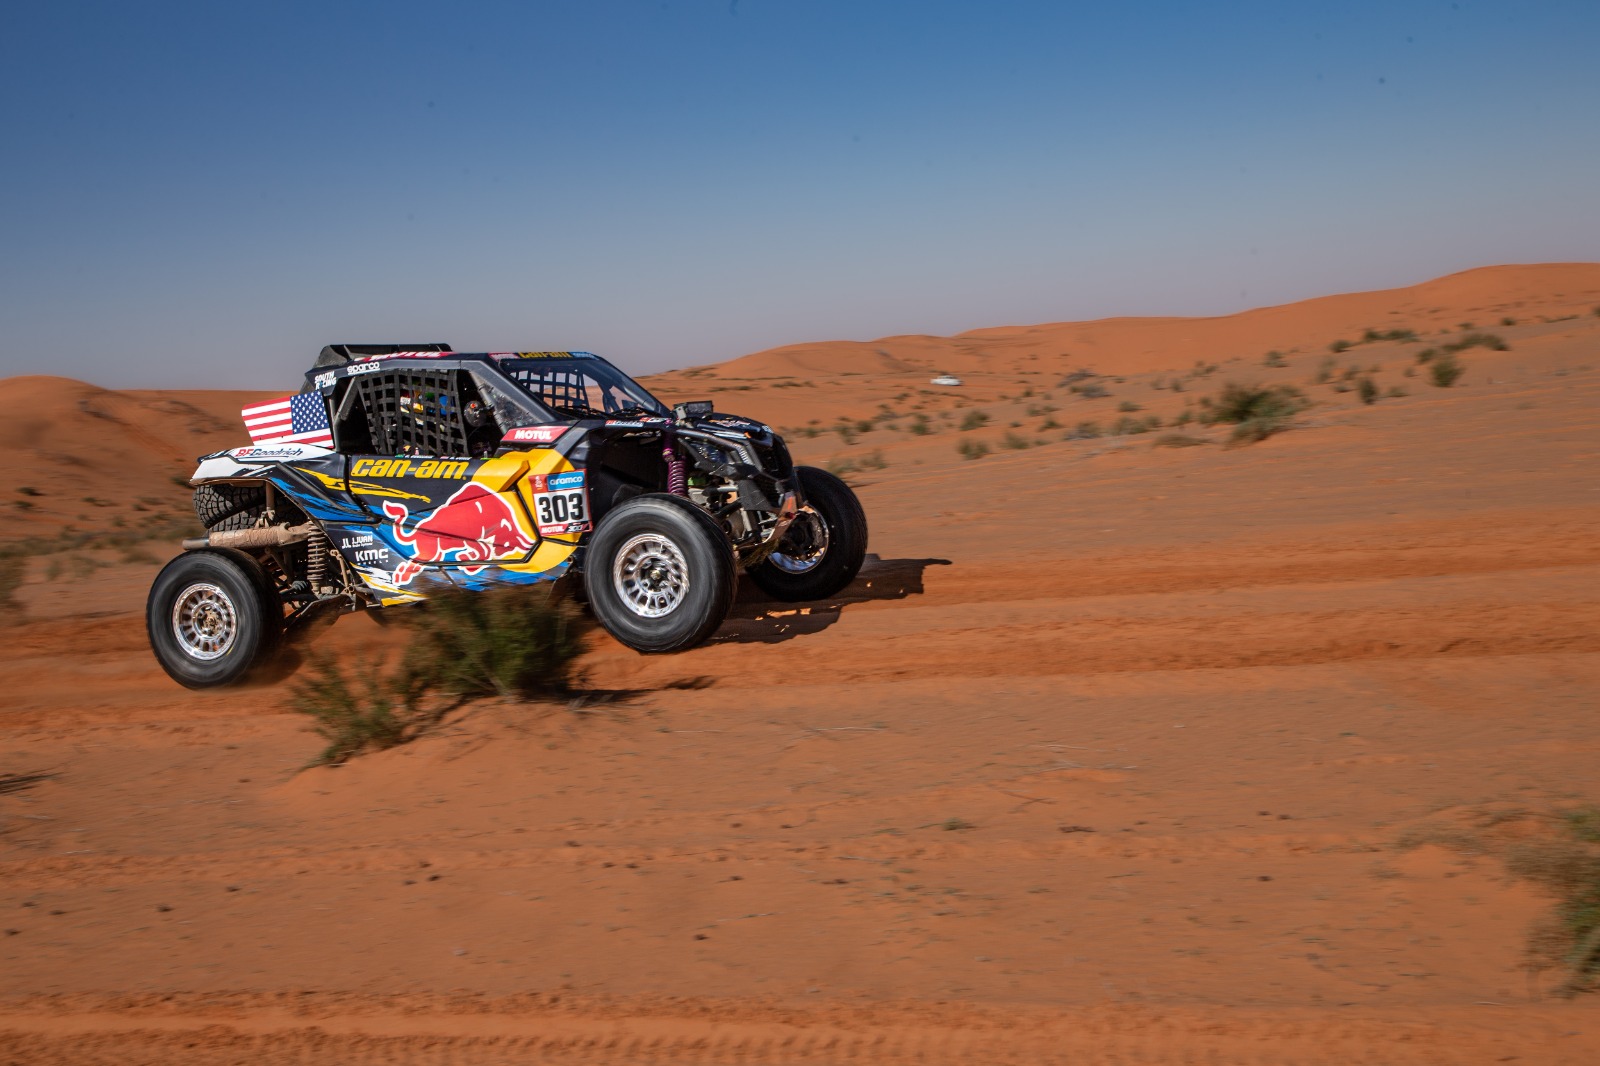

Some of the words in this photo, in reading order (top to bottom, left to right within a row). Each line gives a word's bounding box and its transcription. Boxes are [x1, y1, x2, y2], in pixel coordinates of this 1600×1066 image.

[346, 361, 380, 373] sparco
[315, 371, 335, 384] SOUTH
[514, 429, 552, 440] MOTUL
[350, 459, 470, 480] can-am
[549, 476, 583, 486] aramco
[538, 493, 584, 523] 303
[541, 525, 565, 534] MOTUL
[355, 548, 389, 562] KMC
